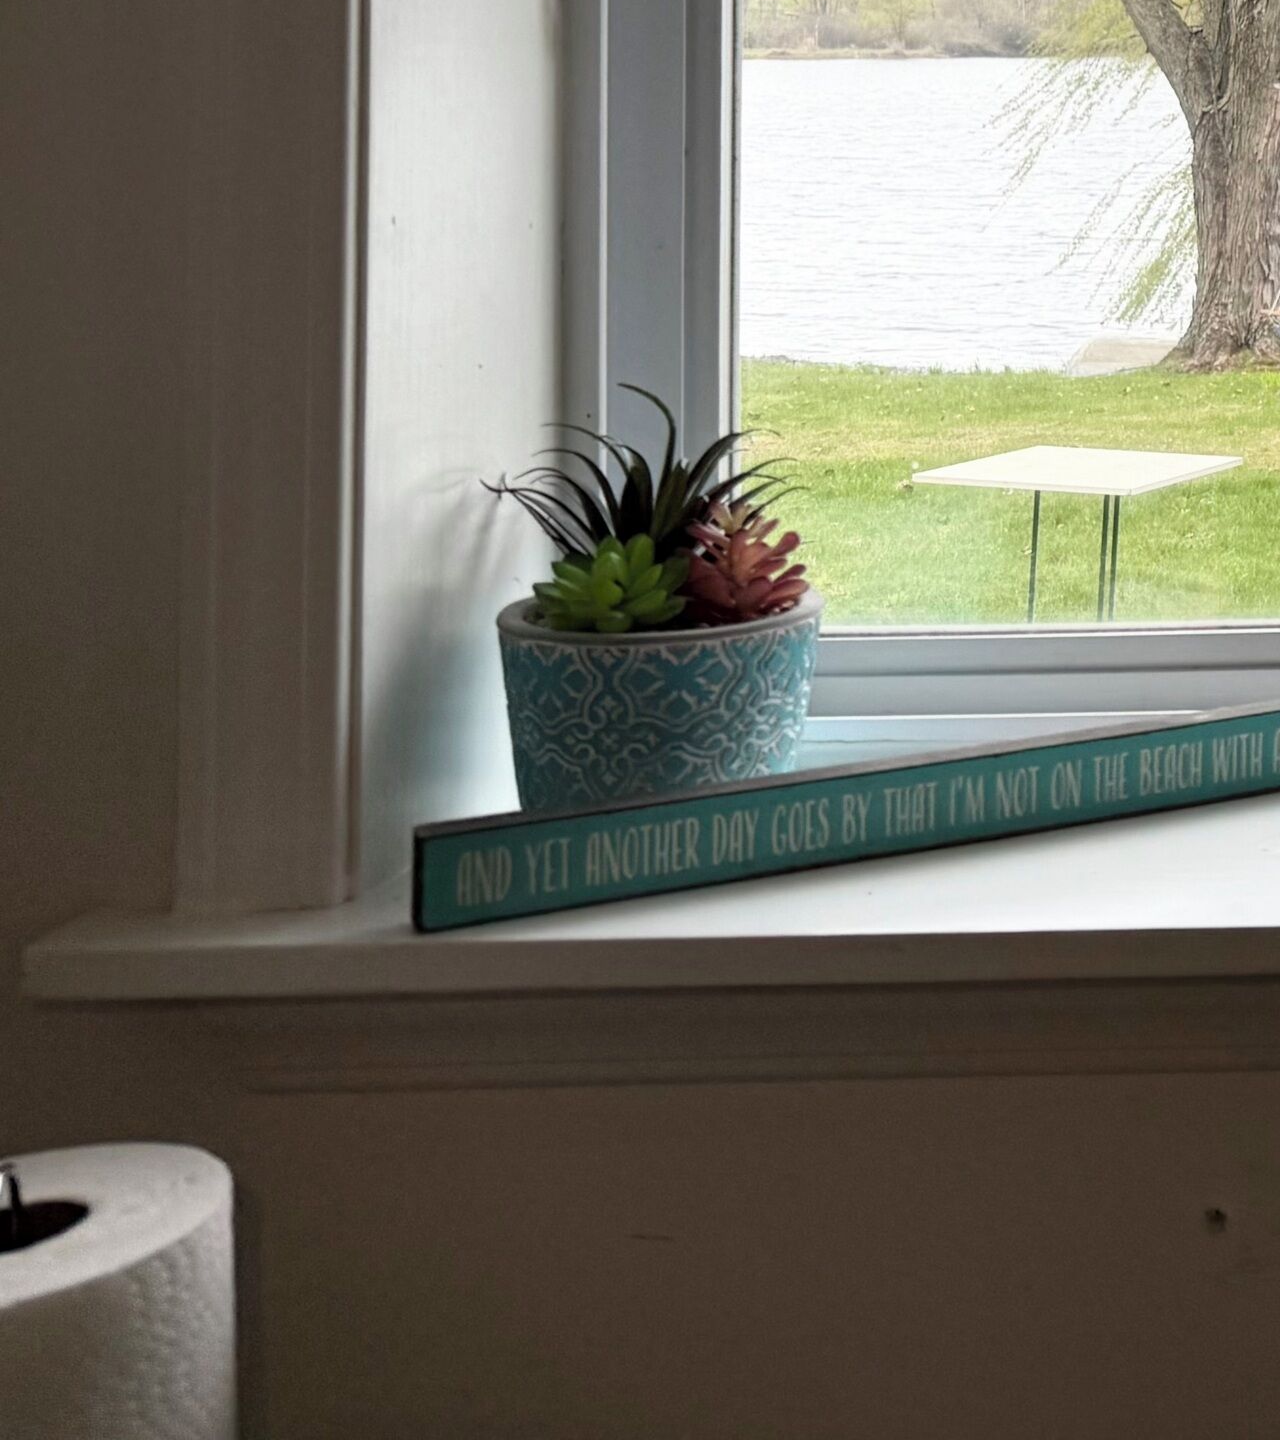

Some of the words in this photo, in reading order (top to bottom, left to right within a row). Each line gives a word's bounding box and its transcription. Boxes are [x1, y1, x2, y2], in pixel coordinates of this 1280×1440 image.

[456, 851, 513, 906] AND
[525, 838, 571, 896] YET
[585, 817, 700, 887] ANOTHER
[712, 809, 759, 866] DAY
[771, 797, 831, 855] GOES
[842, 793, 871, 846] BY
[883, 781, 936, 838] THAT
[949, 776, 986, 826] I'M
[996, 766, 1040, 818] NOT
[1050, 759, 1082, 810] ON
[1094, 752, 1129, 803] THE
[1139, 739, 1202, 797] BEACH
[1212, 731, 1264, 783] WITH
